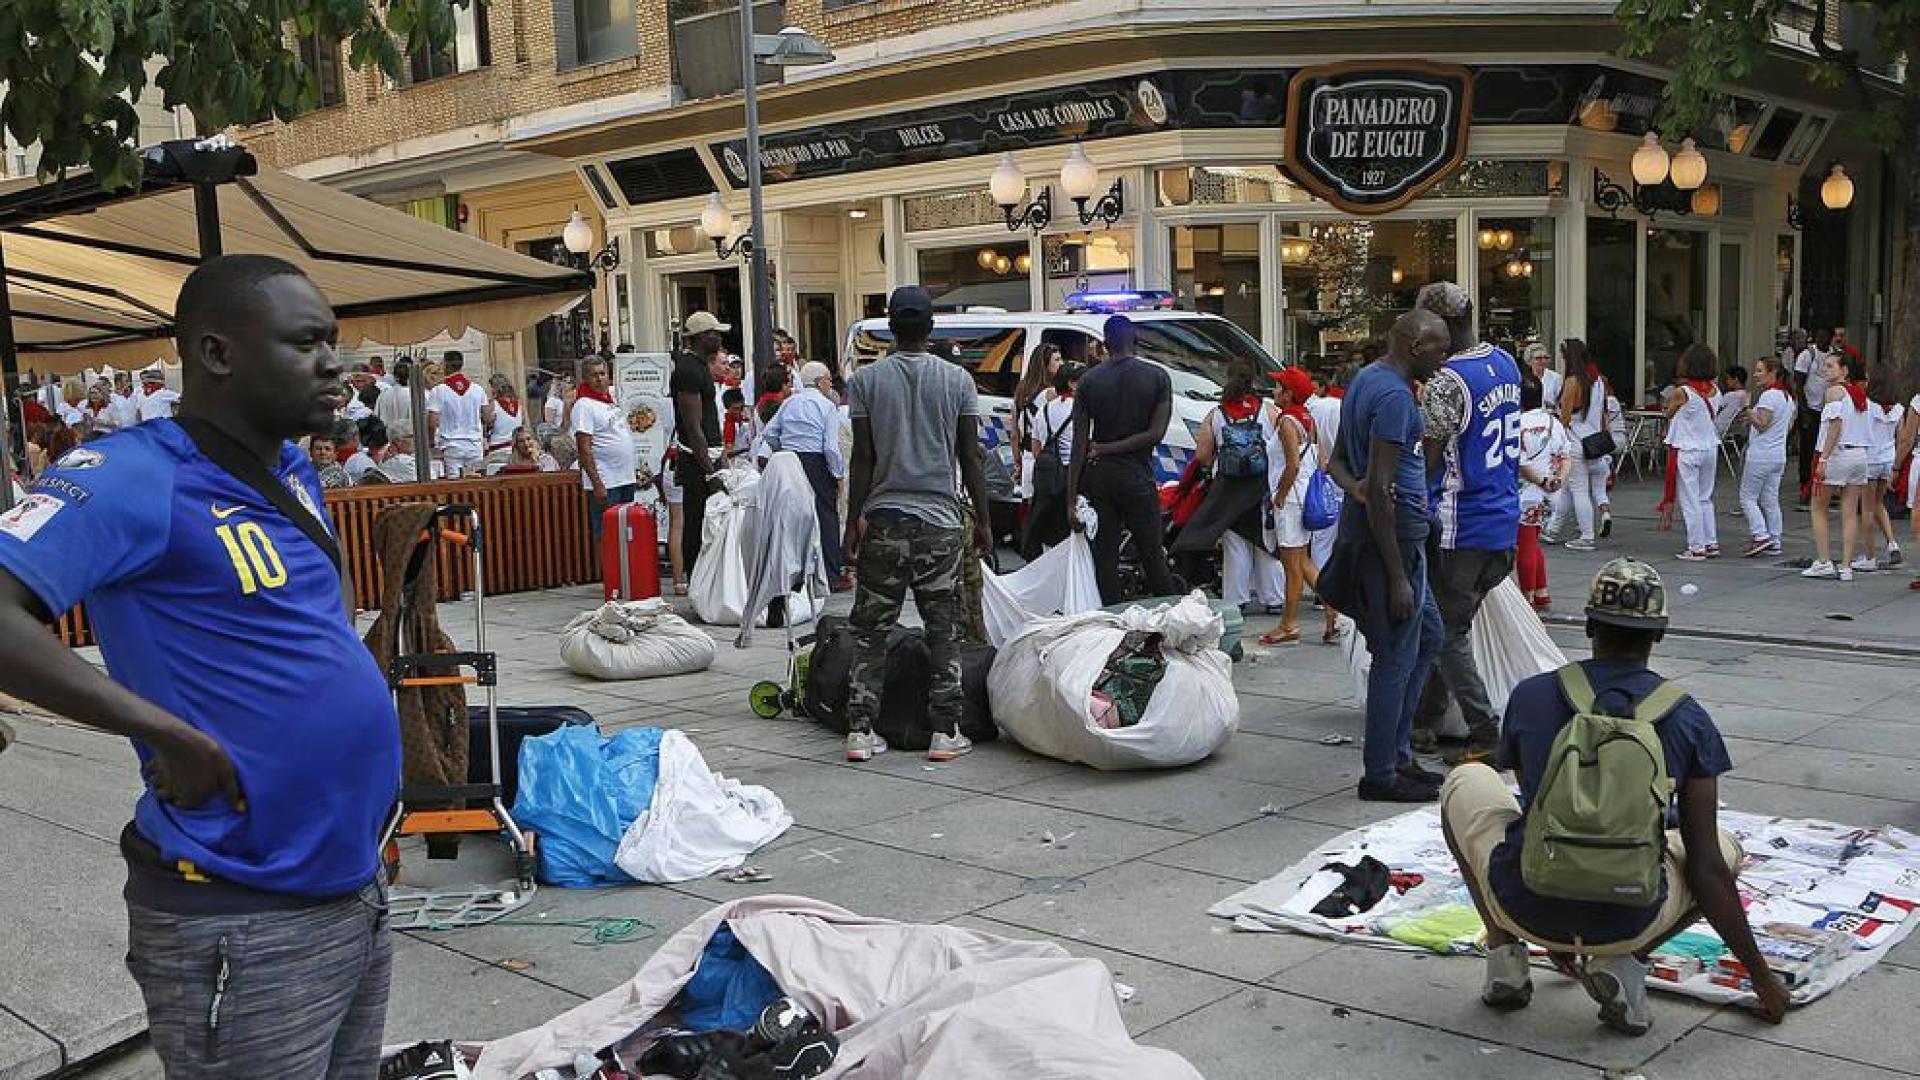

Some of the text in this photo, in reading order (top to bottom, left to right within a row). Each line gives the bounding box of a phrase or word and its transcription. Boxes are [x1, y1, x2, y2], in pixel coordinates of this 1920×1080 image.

[998, 98, 1116, 133] CASA DE COMIDAS
[1324, 98, 1436, 125] PANADERO
[826, 139, 852, 158] PAN
[898, 123, 945, 147] DULCES
[1329, 130, 1427, 158] DE EUGUI
[1482, 410, 1520, 468] 25
[214, 521, 288, 595] 10
[1601, 580, 1657, 612] BOY
